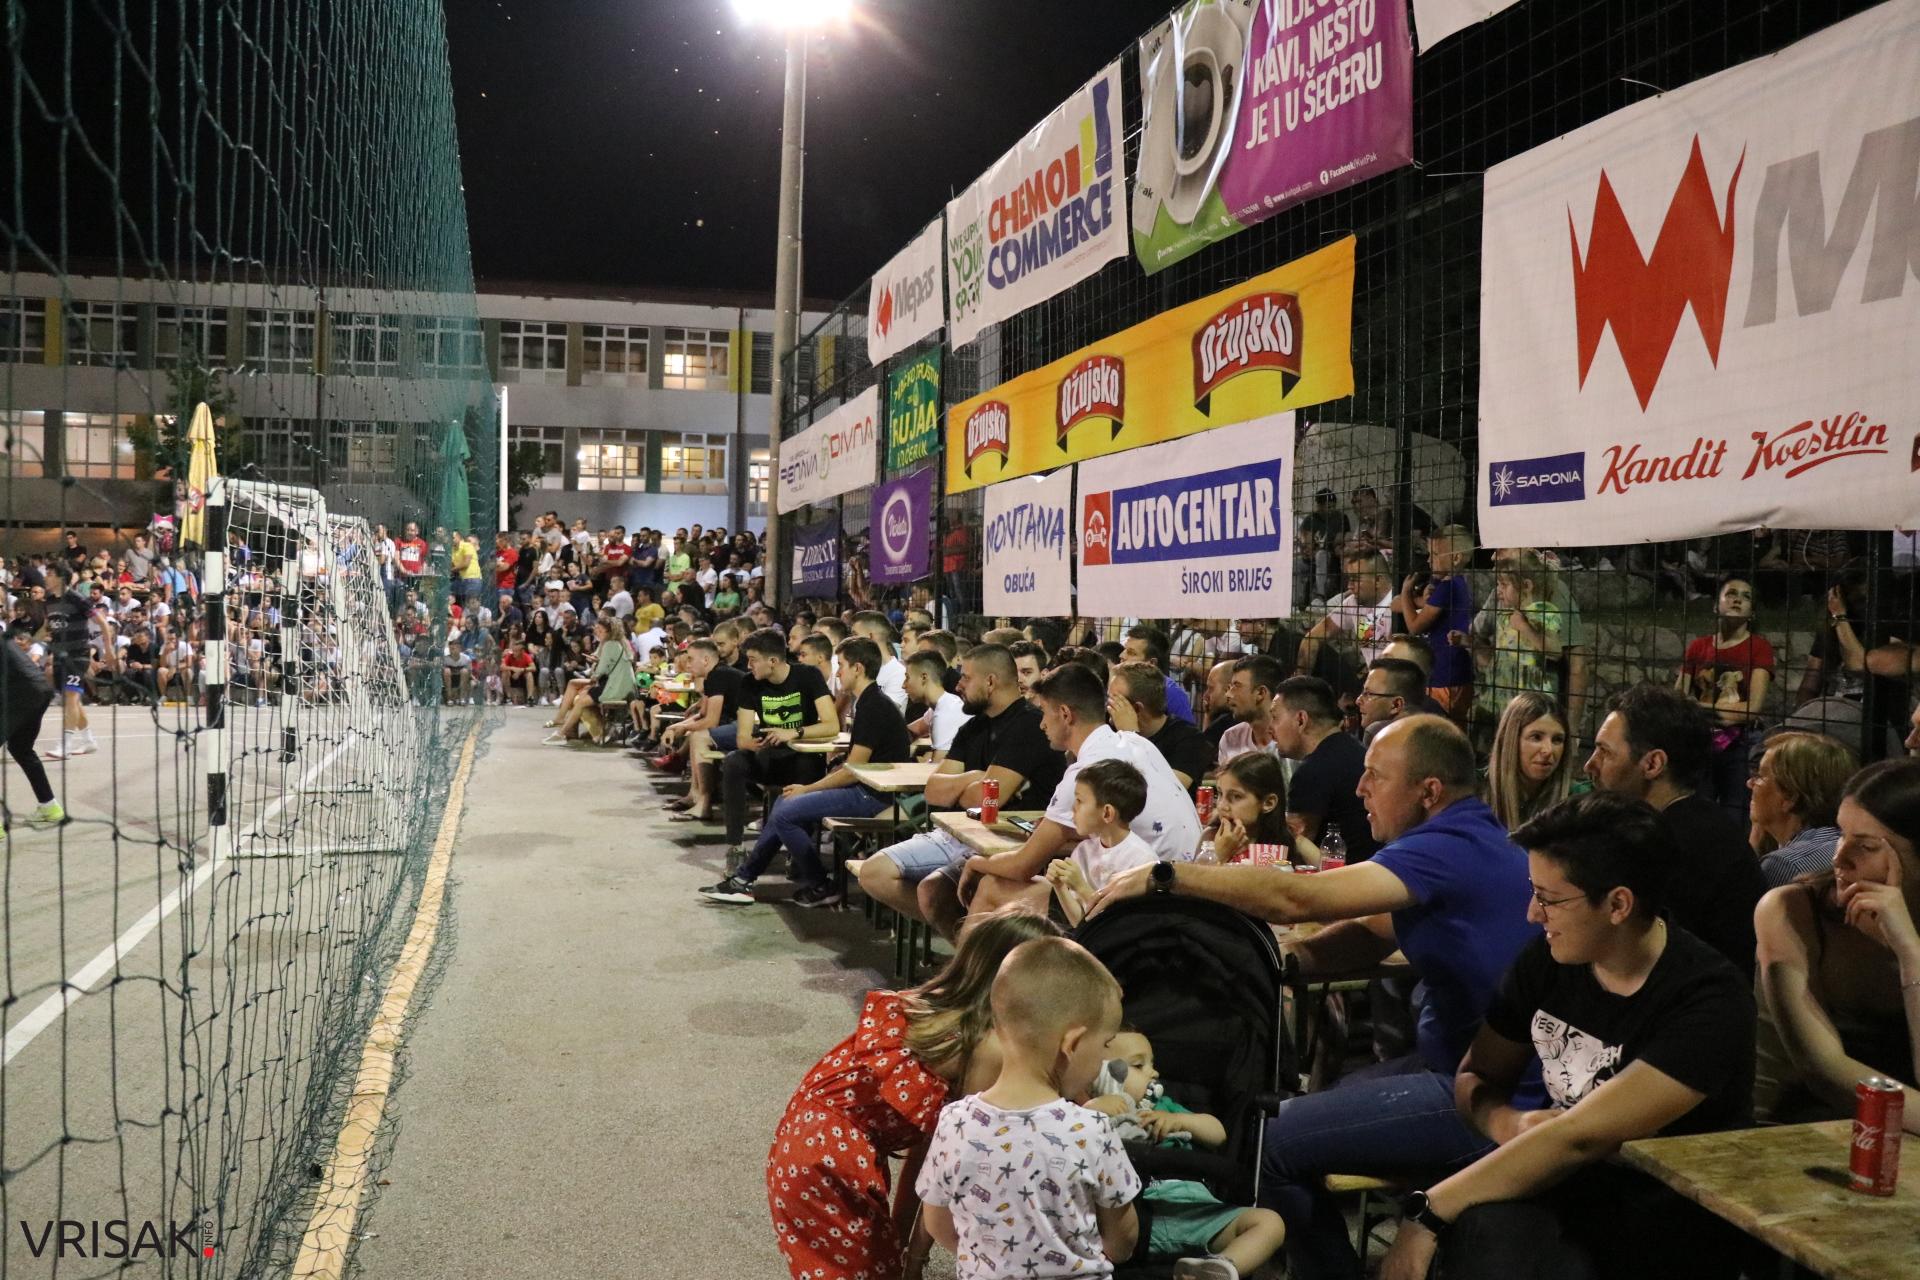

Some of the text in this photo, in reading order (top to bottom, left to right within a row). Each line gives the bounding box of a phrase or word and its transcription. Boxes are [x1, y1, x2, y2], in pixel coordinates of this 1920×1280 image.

[1252, 0, 1376, 98] KAVI, NEŠTO
[1245, 42, 1383, 150] JE I U ŠEĆERU
[988, 157, 1065, 244] CHEMO
[952, 234, 984, 288] YOUR
[988, 176, 1113, 290] COMMERCE
[894, 265, 935, 323] Mepas
[1199, 297, 1293, 384] Ožujsko
[1062, 361, 1120, 426] Ožujsko
[967, 405, 1008, 457] Ožujsko
[1741, 411, 1889, 480] Koestlin
[1516, 470, 1581, 488] SAPONIA
[1597, 437, 1728, 495] Kandit
[986, 503, 1065, 565] MONTANA
[1116, 478, 1277, 551] AUTOCENTAR
[1004, 566, 1035, 593] OBUĆA
[1181, 564, 1273, 595] ŠIROKI BRIJEG
[66, 674, 81, 687] 22
[1533, 1013, 1561, 1038] YES!
